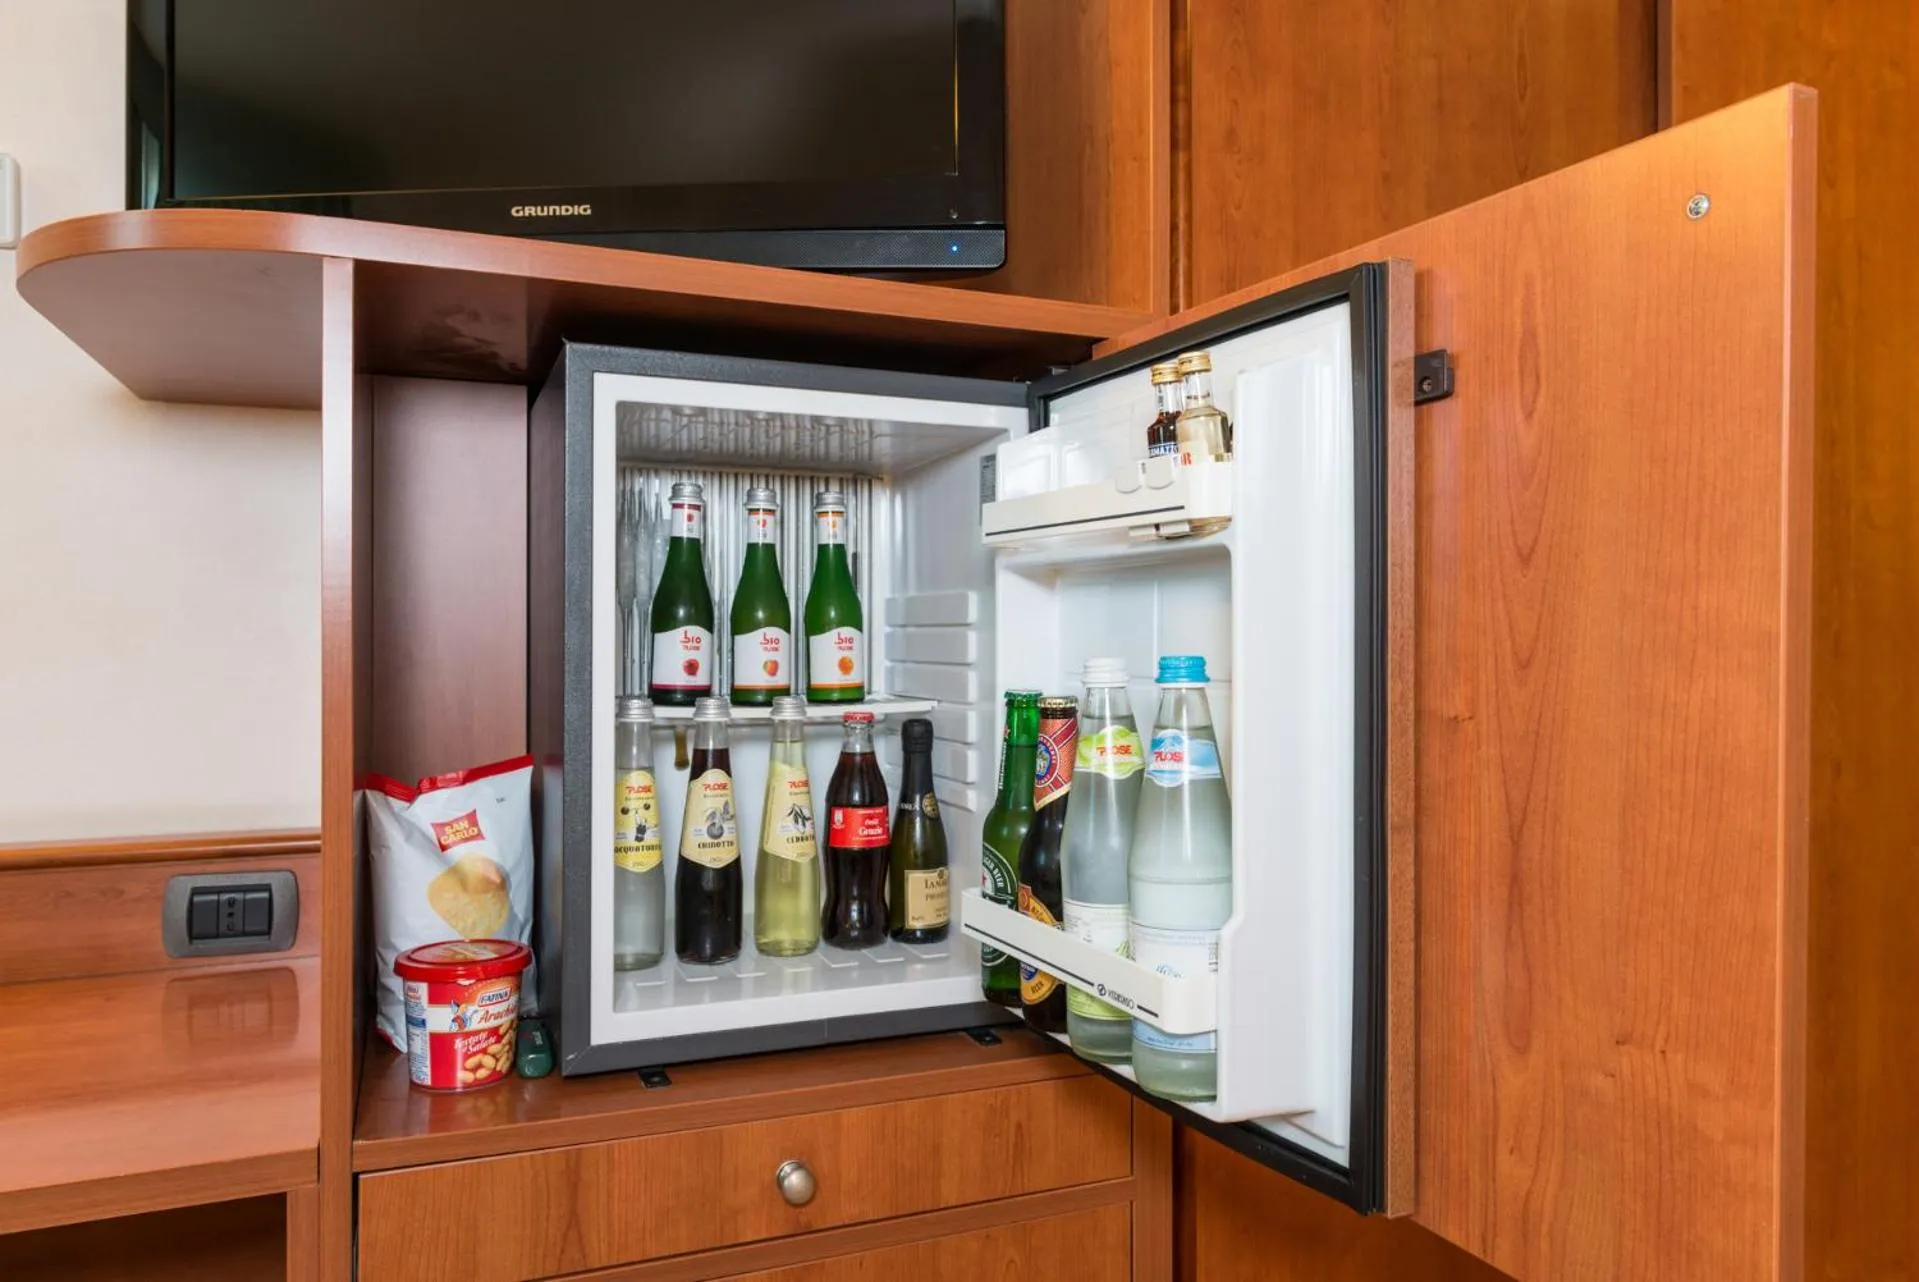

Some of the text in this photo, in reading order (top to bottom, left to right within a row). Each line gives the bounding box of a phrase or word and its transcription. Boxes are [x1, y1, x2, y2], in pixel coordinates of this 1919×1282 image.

[511, 204, 592, 217] GRUNDIG
[1096, 744, 1133, 757] POSE
[445, 820, 469, 834] SAN
[440, 827, 479, 845] CARLO
